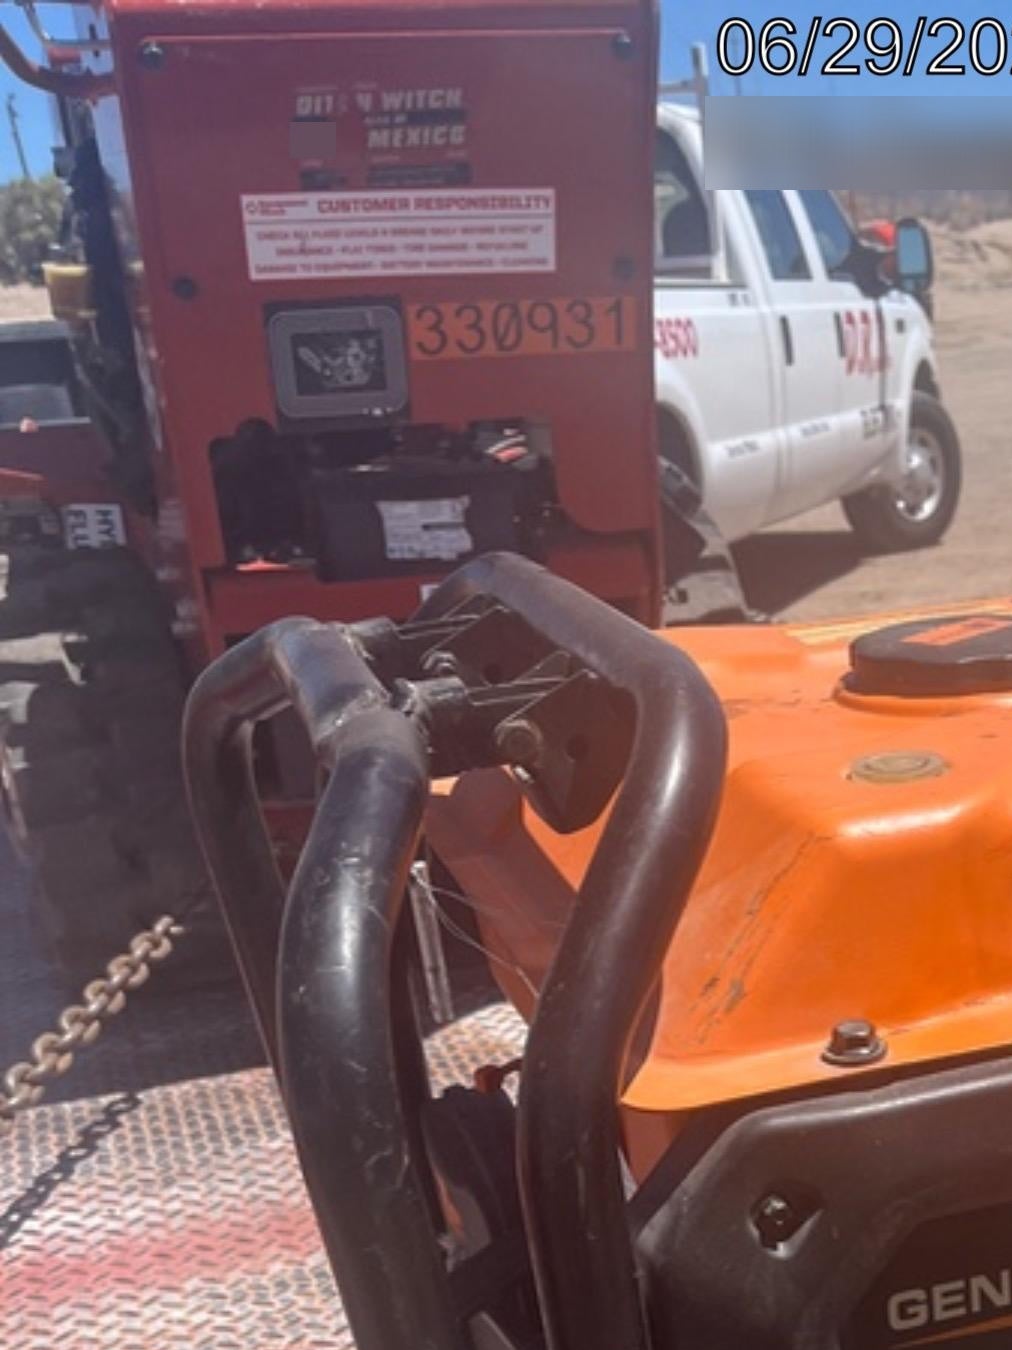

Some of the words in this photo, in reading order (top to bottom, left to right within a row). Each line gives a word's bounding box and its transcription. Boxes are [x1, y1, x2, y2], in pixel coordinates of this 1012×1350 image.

[380, 88, 463, 112] WITCH
[367, 125, 466, 149] MEXICO
[317, 198, 412, 214] CUSTOMER
[414, 194, 551, 212] RESPONSIBILITY
[415, 301, 627, 356] 330931
